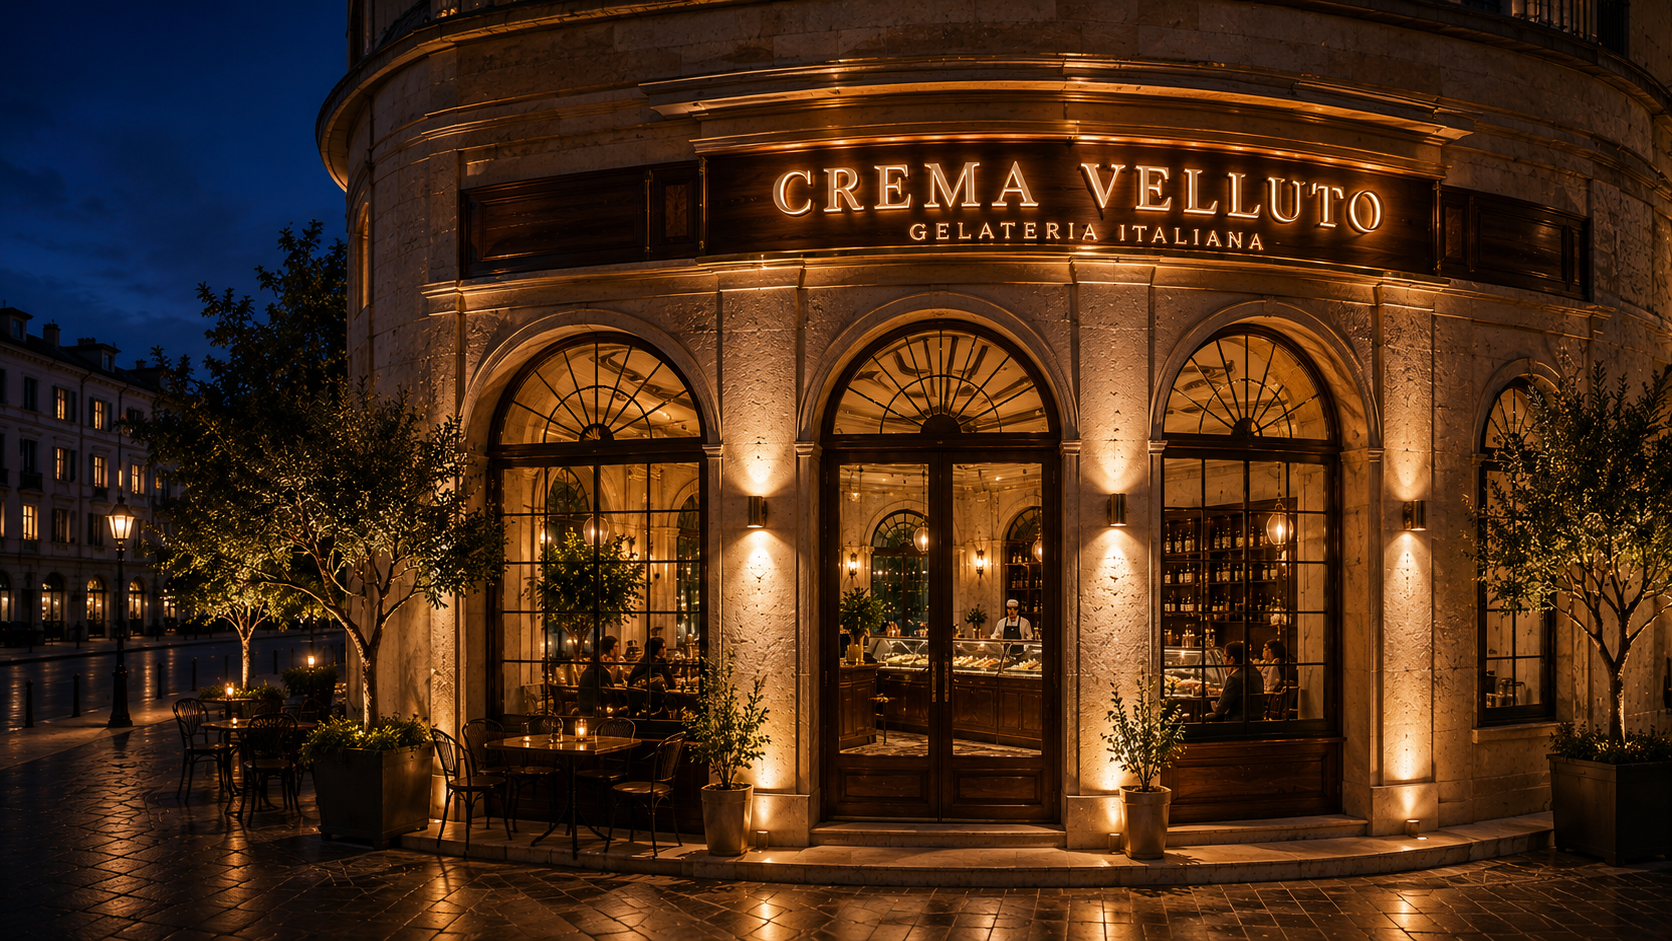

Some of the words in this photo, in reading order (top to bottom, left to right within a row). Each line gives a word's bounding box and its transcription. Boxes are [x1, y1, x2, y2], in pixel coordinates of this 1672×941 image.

[773, 161, 1039, 215] CREMA
[1080, 163, 1384, 233] VELLUTO
[909, 222, 1097, 242] GELATERIA
[1119, 224, 1264, 251] ITALIANA
